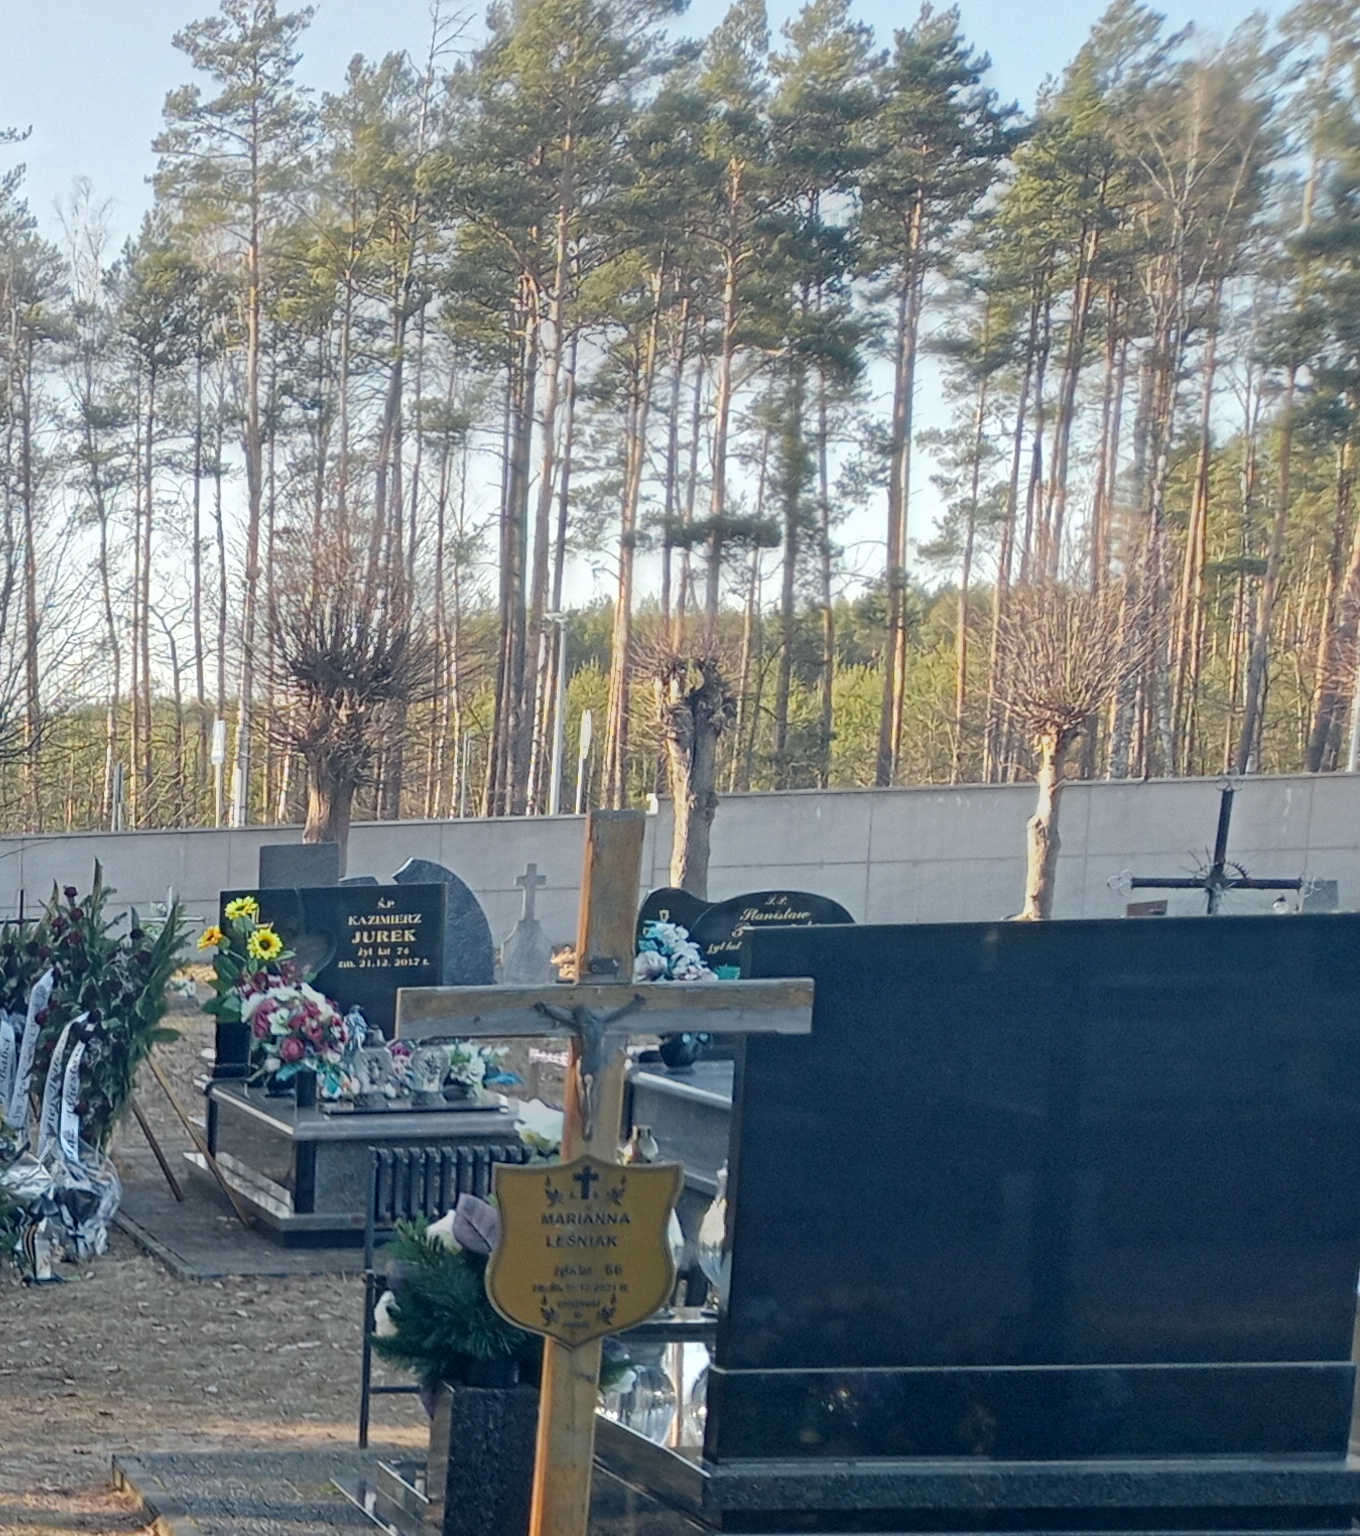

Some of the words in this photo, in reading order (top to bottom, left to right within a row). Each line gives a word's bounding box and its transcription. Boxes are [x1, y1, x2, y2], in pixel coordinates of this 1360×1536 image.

[347, 913, 423, 926] KAZIMIERZ
[351, 929, 417, 944] JUREK
[541, 1212, 630, 1225] MARIANNA
[545, 1233, 618, 1248] LEŚNIAK
